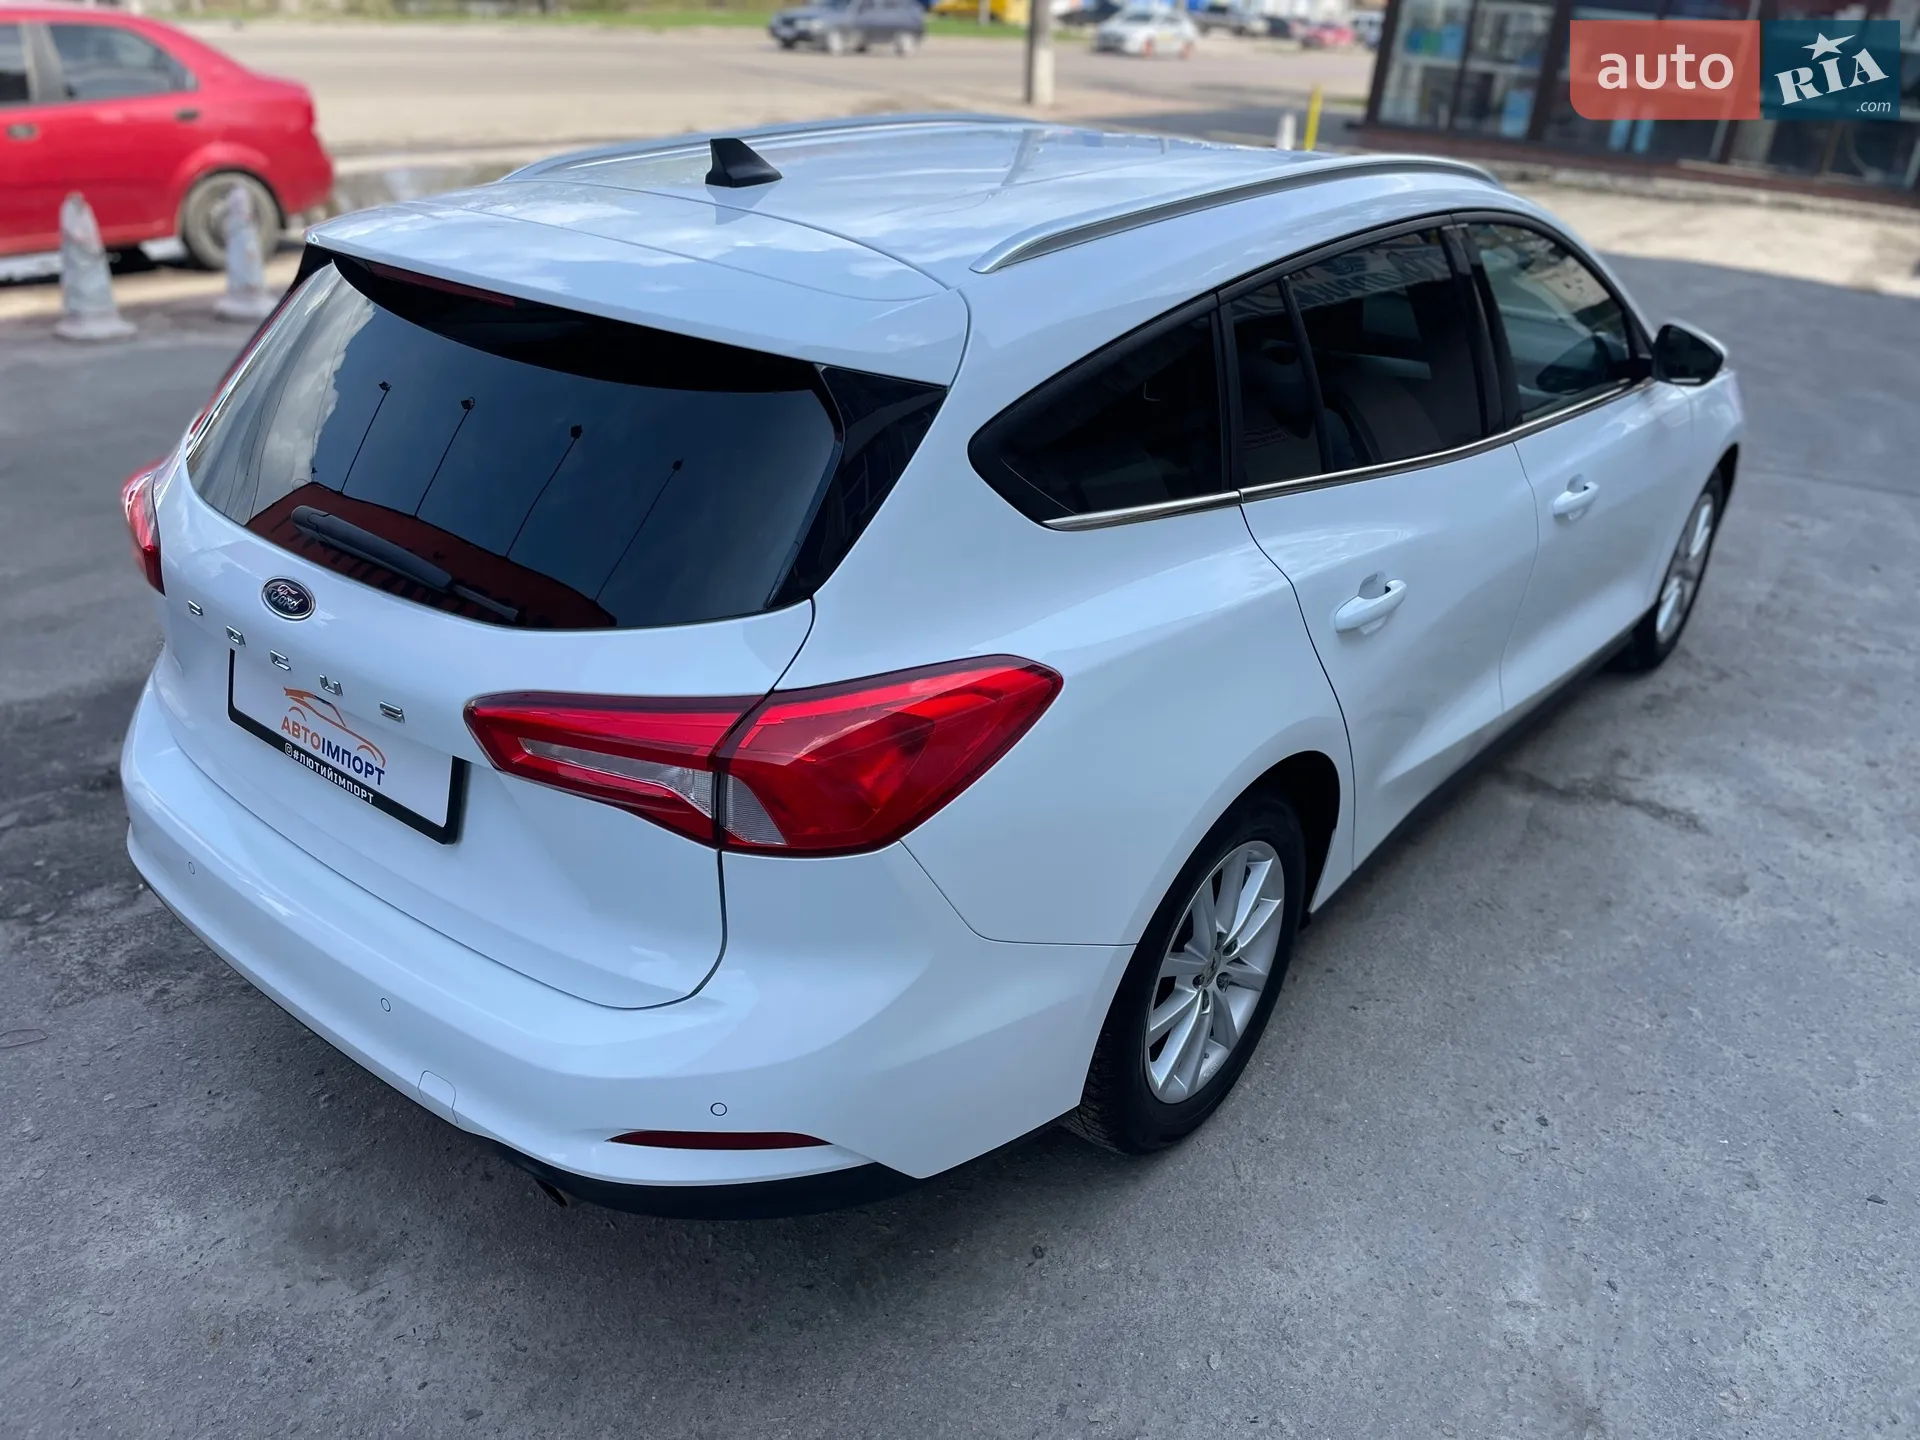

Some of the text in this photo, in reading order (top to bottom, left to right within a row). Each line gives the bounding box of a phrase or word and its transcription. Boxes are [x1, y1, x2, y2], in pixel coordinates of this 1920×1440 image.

[270, 583, 304, 613] Ford
[187, 599, 406, 724] FOCUS
[281, 715, 385, 786] АВТОІМПОРТ
